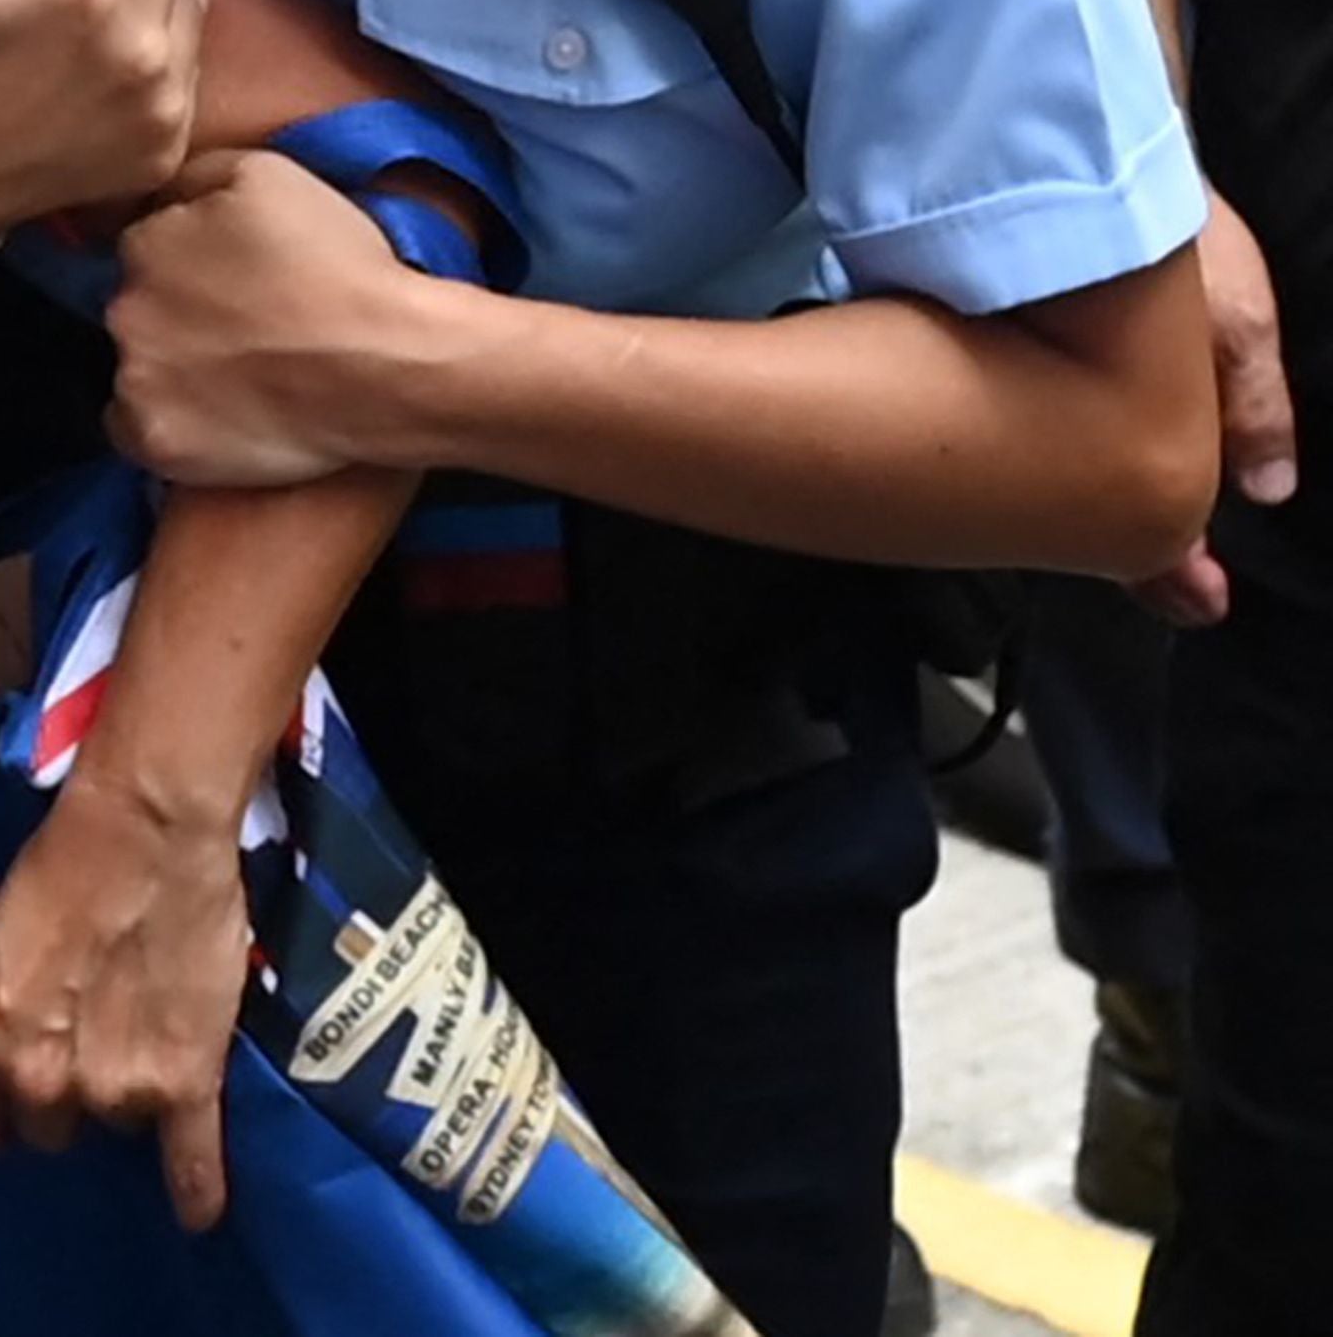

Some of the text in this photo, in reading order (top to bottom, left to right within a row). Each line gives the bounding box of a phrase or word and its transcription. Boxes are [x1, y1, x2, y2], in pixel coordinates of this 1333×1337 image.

[304, 893, 450, 1063] BONDI BEACH
[411, 979, 467, 1087] MANLY
[420, 1078, 496, 1173] OPERA
[465, 1114, 535, 1212] SYDNEY
